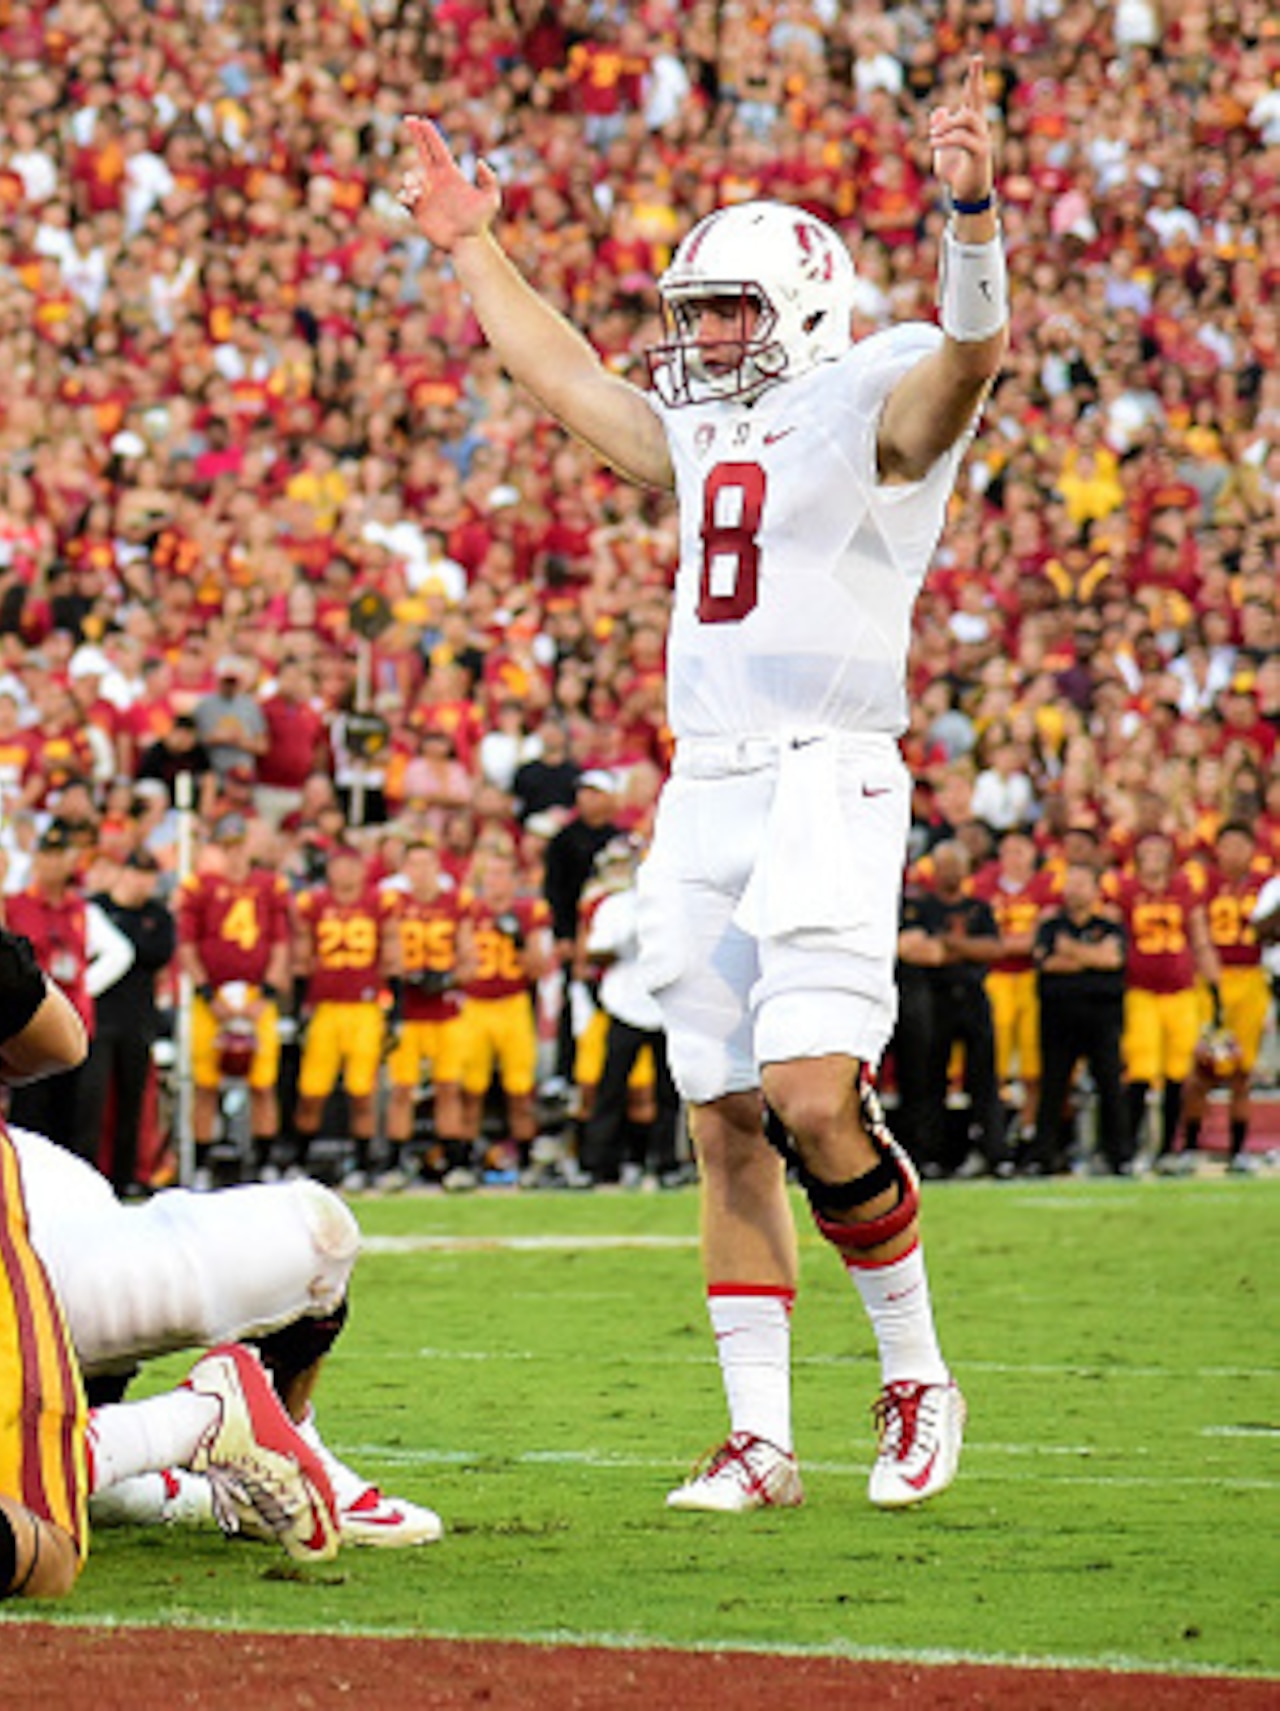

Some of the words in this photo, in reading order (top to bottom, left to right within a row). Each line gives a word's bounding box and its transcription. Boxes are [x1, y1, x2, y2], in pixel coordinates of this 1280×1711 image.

[696, 461, 767, 624] 8
[221, 898, 260, 951] 4
[317, 916, 378, 970] 29
